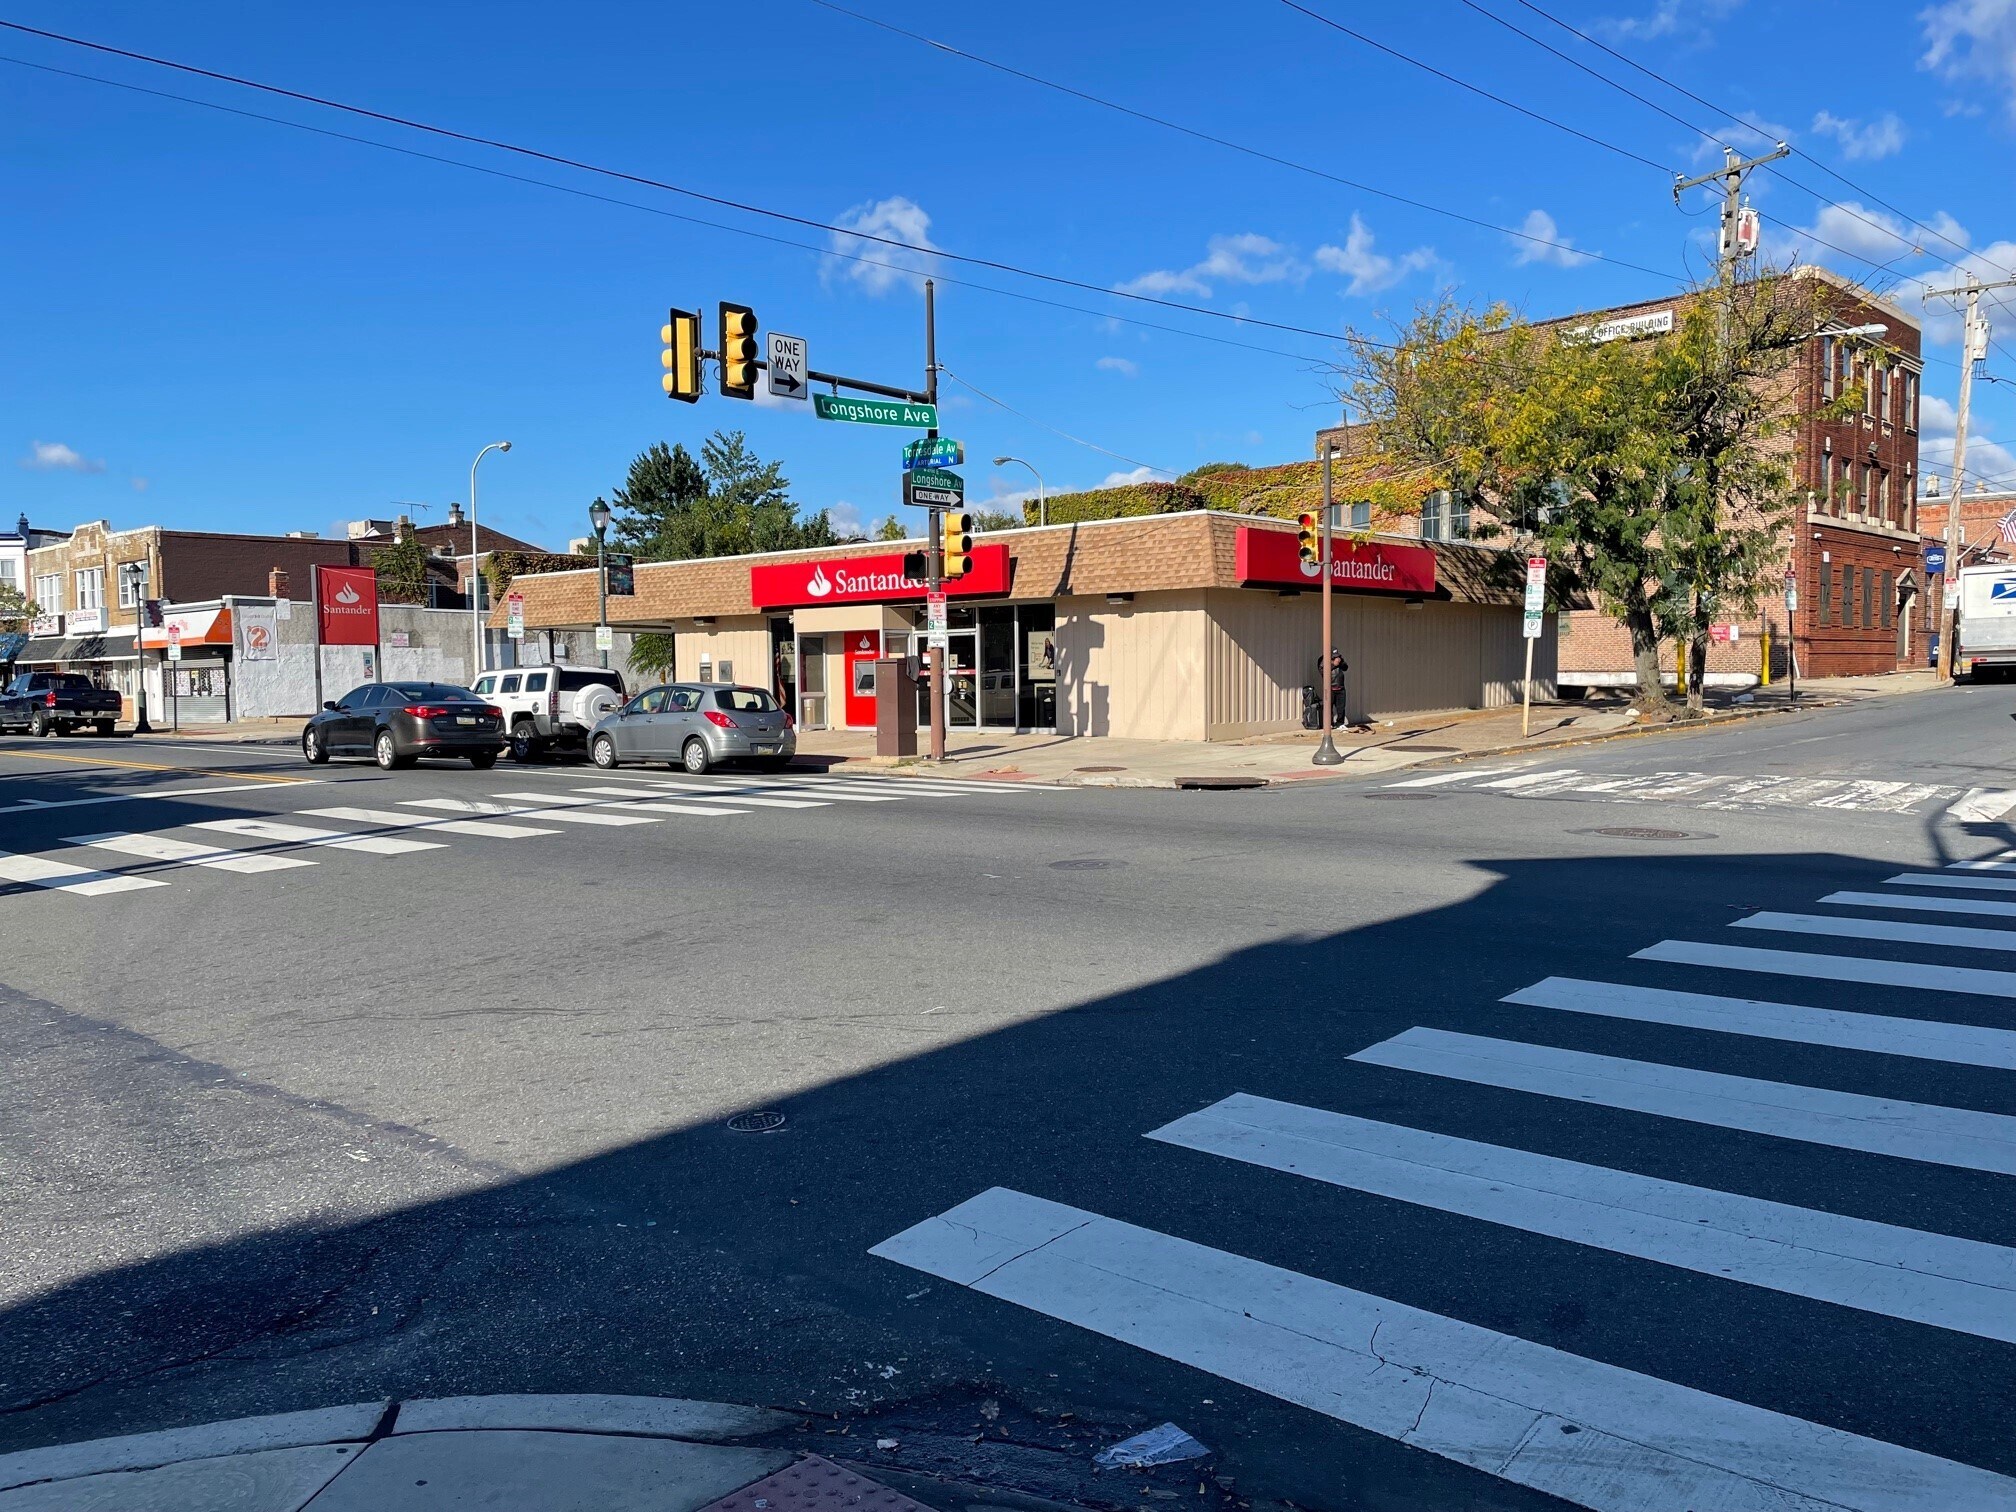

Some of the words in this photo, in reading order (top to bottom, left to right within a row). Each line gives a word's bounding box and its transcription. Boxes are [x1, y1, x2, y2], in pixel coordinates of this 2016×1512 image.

[1598, 325, 1626, 338] OFFICE
[775, 339, 800, 357] ONE
[775, 355, 800, 373] WAY
[821, 399, 898, 421] Longshore
[903, 408, 930, 423] Ave
[904, 444, 943, 457] Torresdale
[946, 443, 956, 454] Av
[948, 456, 954, 464] N
[912, 472, 951, 487] Longshore
[1331, 551, 1395, 581] antander
[323, 604, 372, 615] Santander
